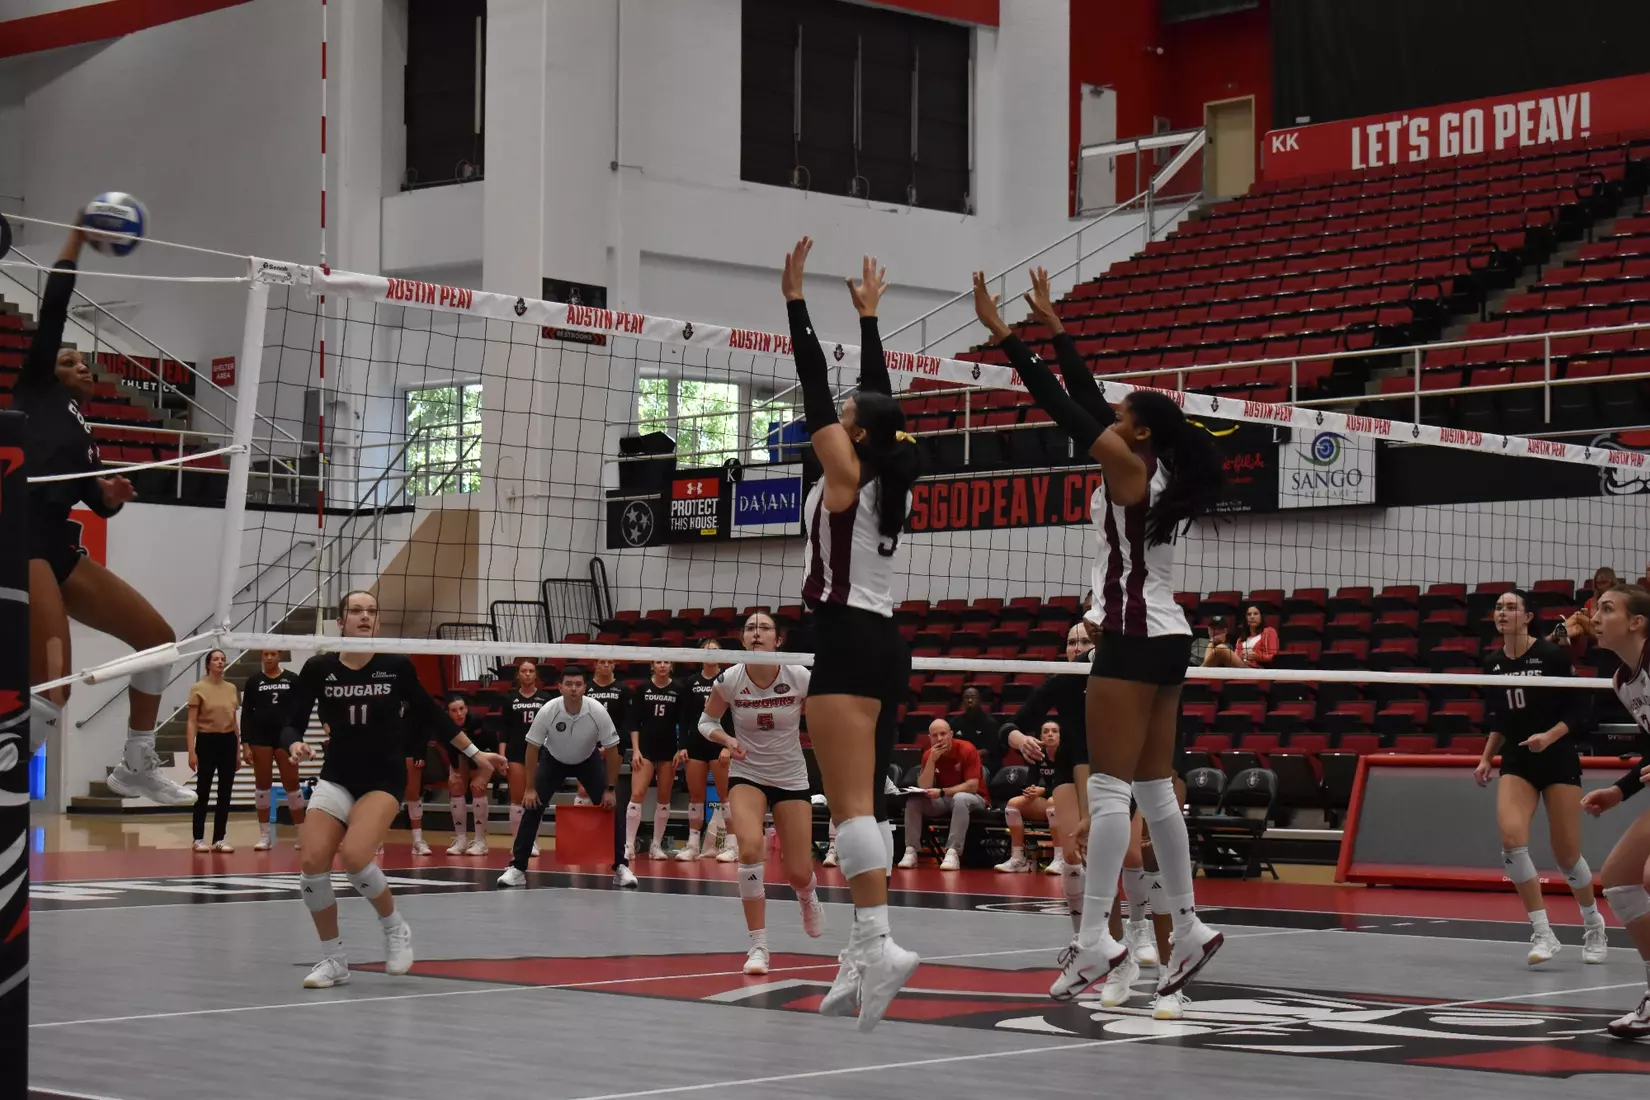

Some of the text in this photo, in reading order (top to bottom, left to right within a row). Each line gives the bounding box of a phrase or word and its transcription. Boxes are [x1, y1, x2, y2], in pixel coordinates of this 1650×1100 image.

[1352, 92, 1590, 170] LET'S GO PEAY!
[1272, 133, 1299, 153] KK
[386, 277, 473, 310] AUSTIN PEAY
[566, 304, 645, 334] AUSTIN PEAY
[729, 328, 794, 355] AUSTIN PEA
[212, 362, 235, 373] SHELTER
[883, 350, 941, 376] USTIN PEAY
[216, 371, 231, 381] AREA
[121, 379, 177, 393] THLETCS
[1244, 401, 1293, 422] AUSTIN PEAY
[1346, 414, 1392, 436] AUSTIN PEAY
[1439, 427, 1484, 447] AUSTIN PEAY
[1527, 438, 1566, 458] AUSTIN PEAY
[1608, 450, 1646, 468] AUSTIN PEAY
[726, 468, 736, 483] K
[1292, 469, 1363, 491] SANGO
[671, 498, 720, 518] PROTECT
[740, 490, 796, 514] DASANI
[671, 515, 720, 531] THIS HOUSE.
[258, 683, 291, 692] COUGARS
[324, 683, 392, 698] COUGARS
[587, 692, 620, 700] COUGARS
[692, 686, 712, 694] COUG
[272, 692, 279, 704] 2
[645, 694, 676, 703] COUGARS
[734, 695, 796, 709] COUGARS
[1506, 688, 1526, 709] 10
[349, 704, 368, 725] 11
[523, 711, 535, 723] 19
[654, 703, 665, 716] 15
[757, 713, 775, 731] 5
